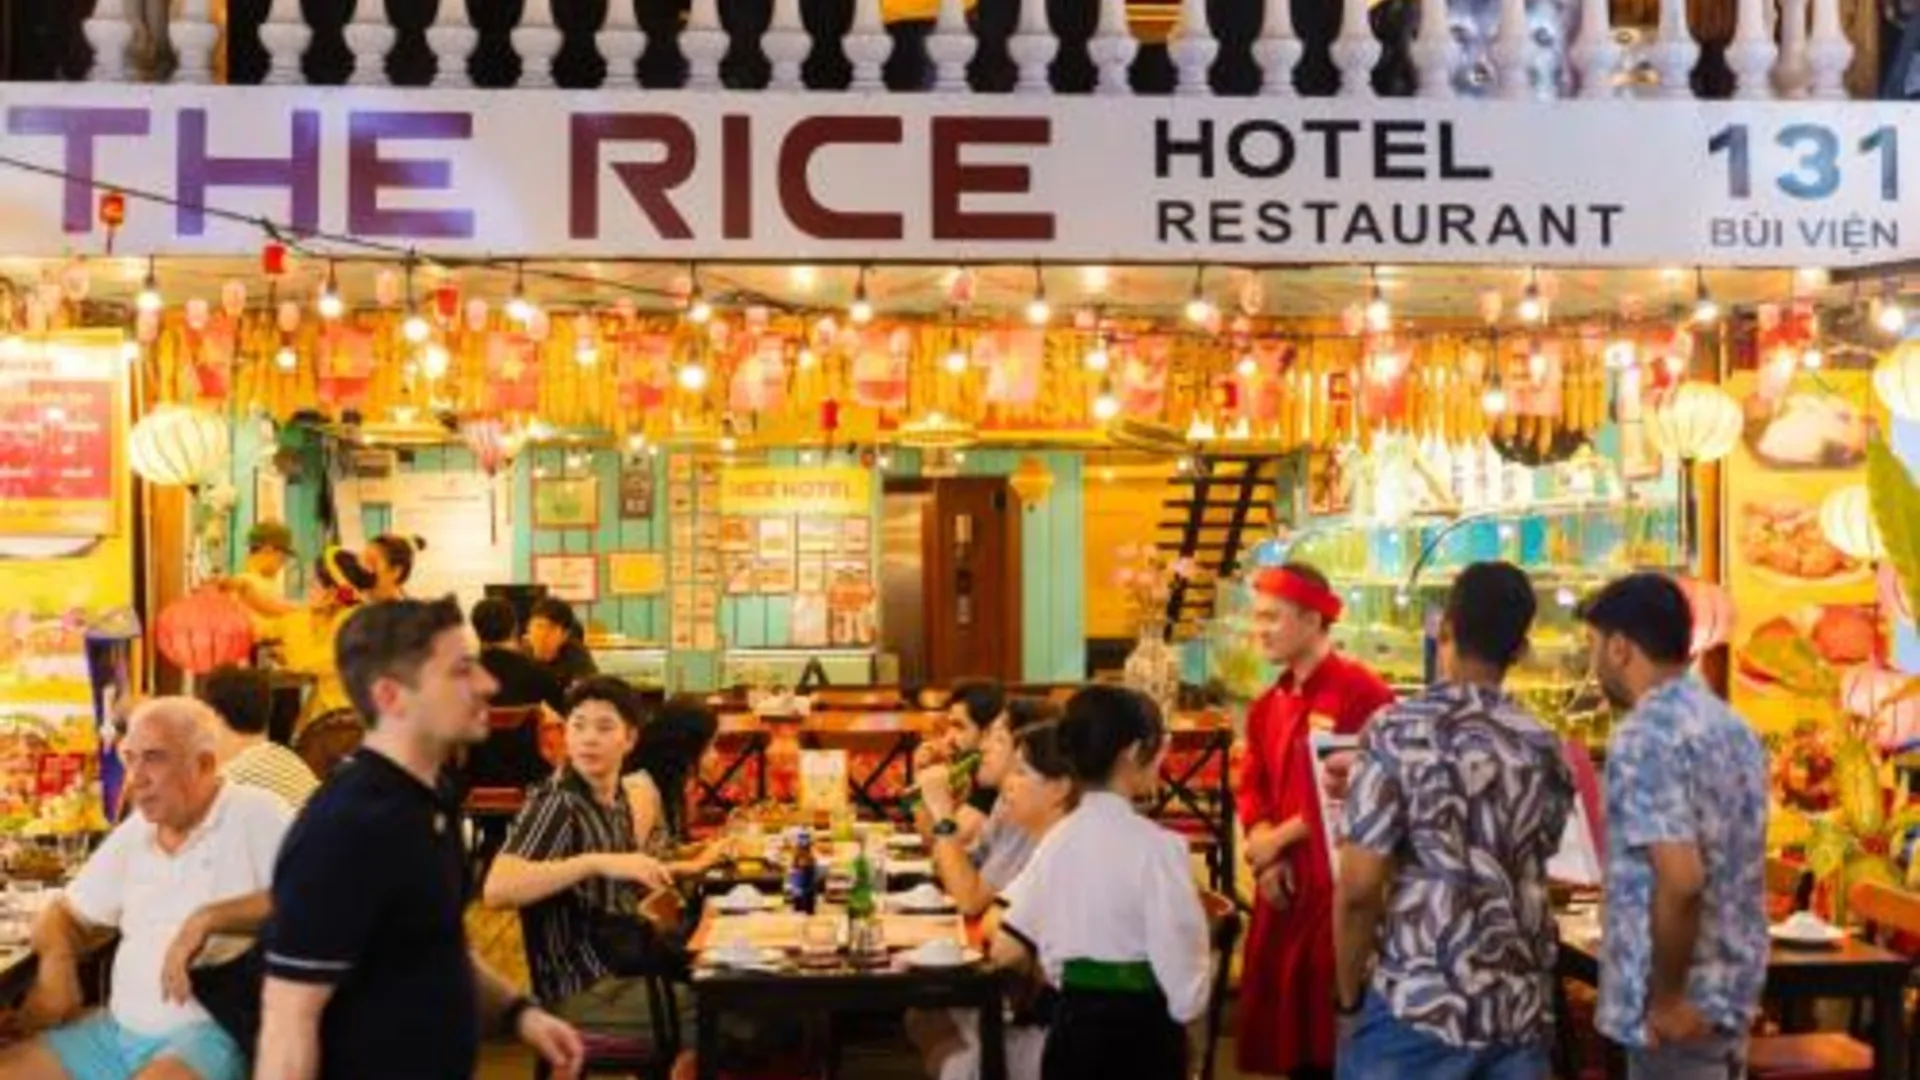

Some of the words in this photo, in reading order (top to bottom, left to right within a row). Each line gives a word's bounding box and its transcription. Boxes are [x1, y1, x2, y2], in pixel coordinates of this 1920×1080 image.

[7, 106, 475, 239] THE
[569, 112, 1056, 240] RICE
[1155, 118, 1492, 179] HOTEL
[1708, 123, 1899, 201] 131
[1157, 200, 1624, 247] RESTAURANT
[1711, 212, 1783, 248] BÙI
[1798, 212, 1899, 254] VIỆN
